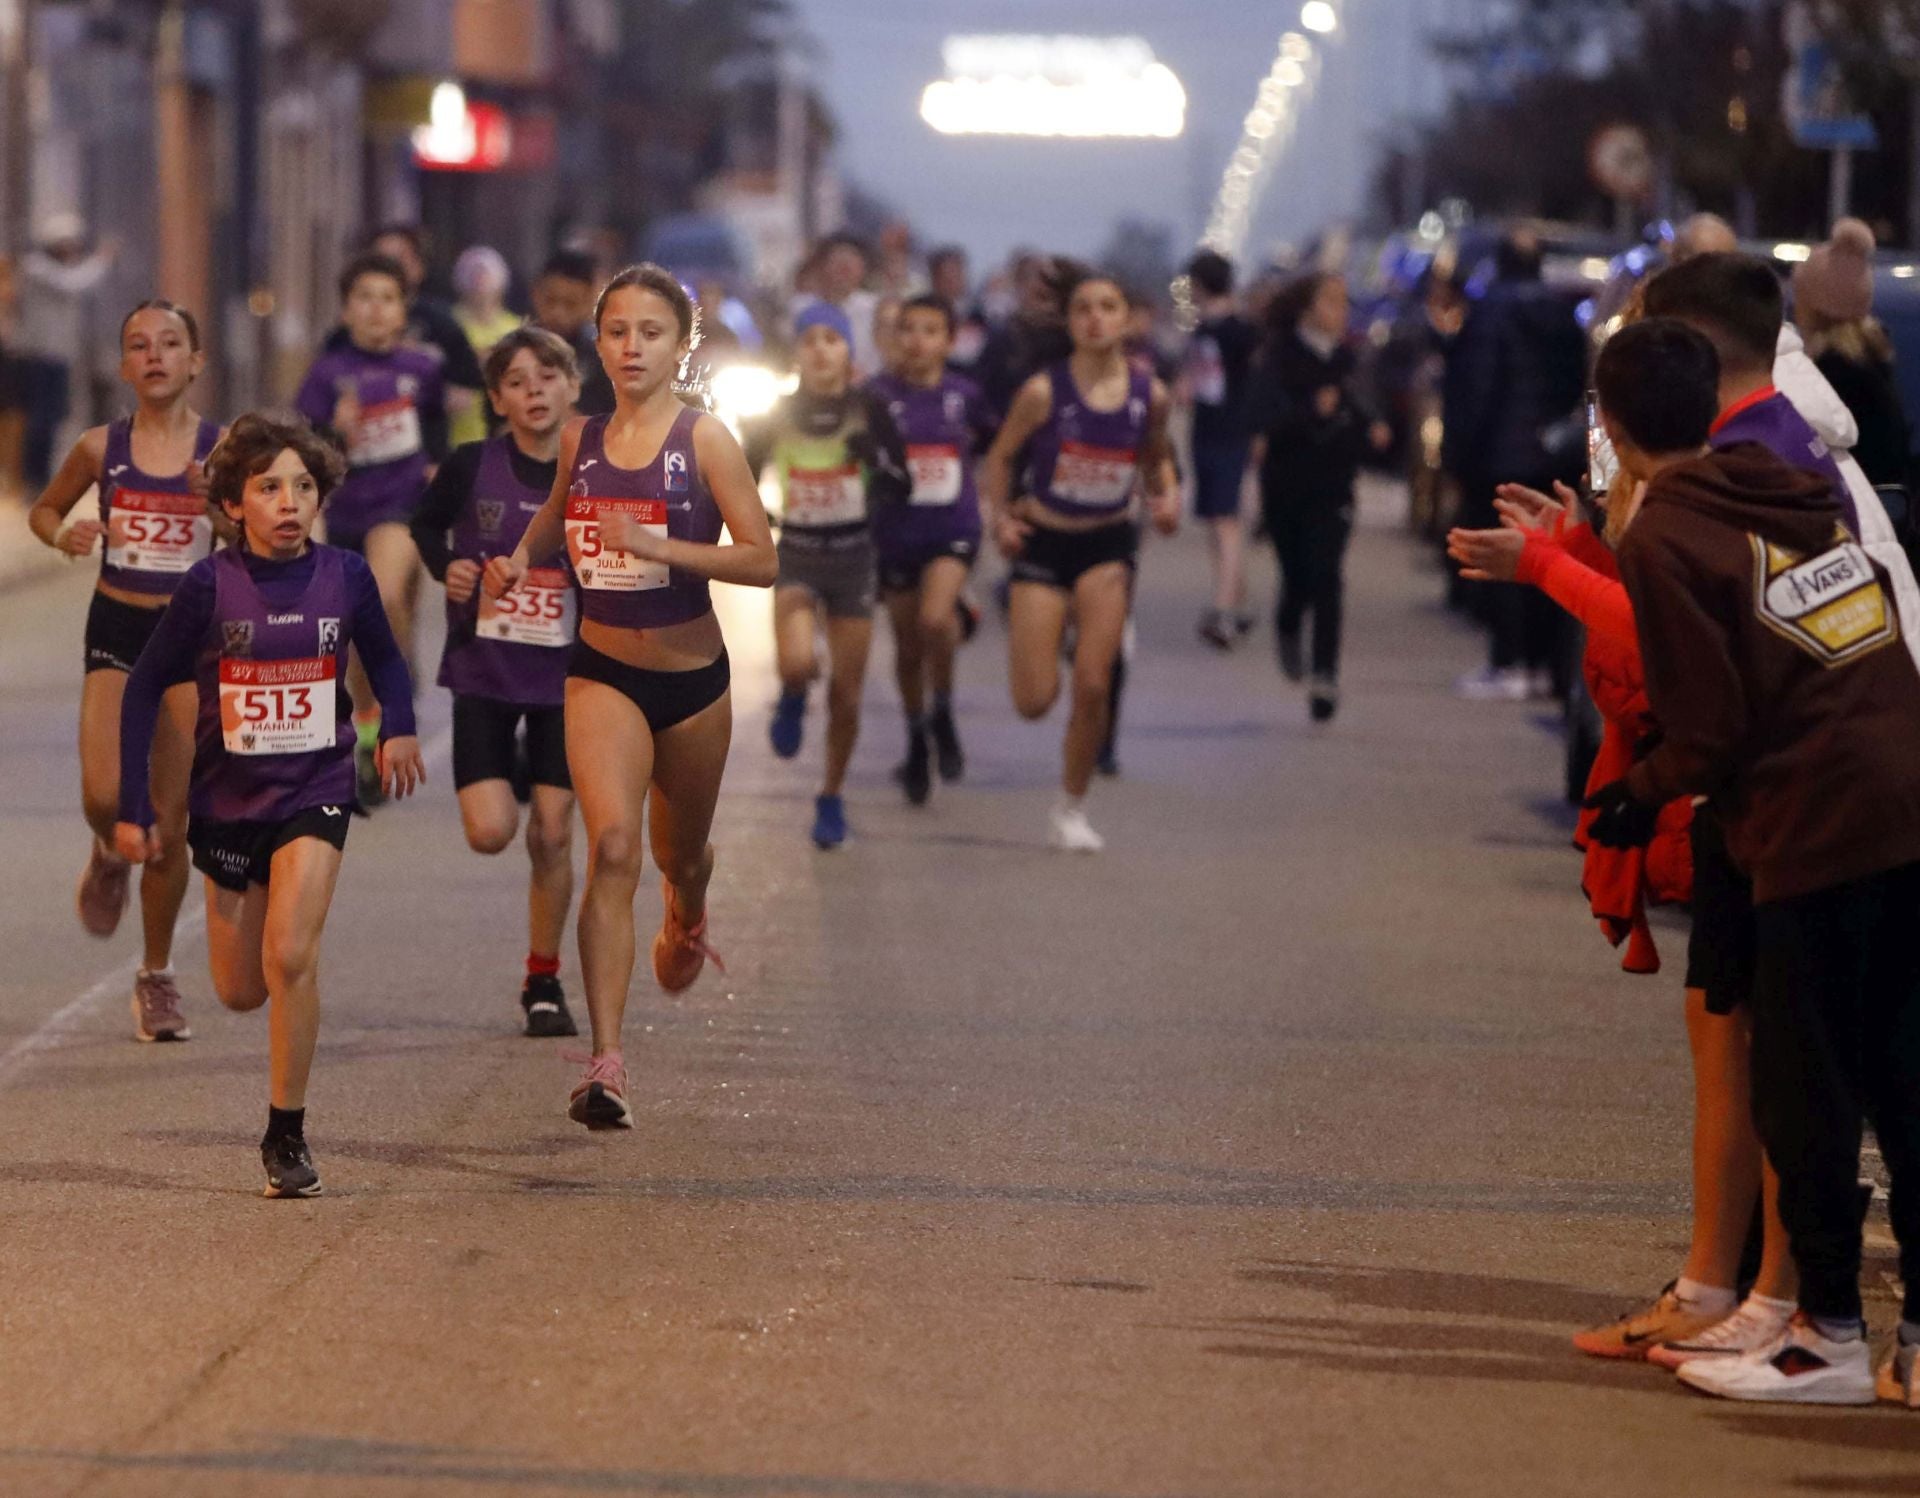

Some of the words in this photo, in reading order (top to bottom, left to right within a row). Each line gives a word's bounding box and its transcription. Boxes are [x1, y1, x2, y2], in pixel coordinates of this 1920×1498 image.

[127, 515, 193, 545] 523
[596, 560, 627, 569] JULIA
[1803, 557, 1853, 593] VANS
[243, 687, 313, 721] 513
[252, 720, 305, 733] MANUEL
